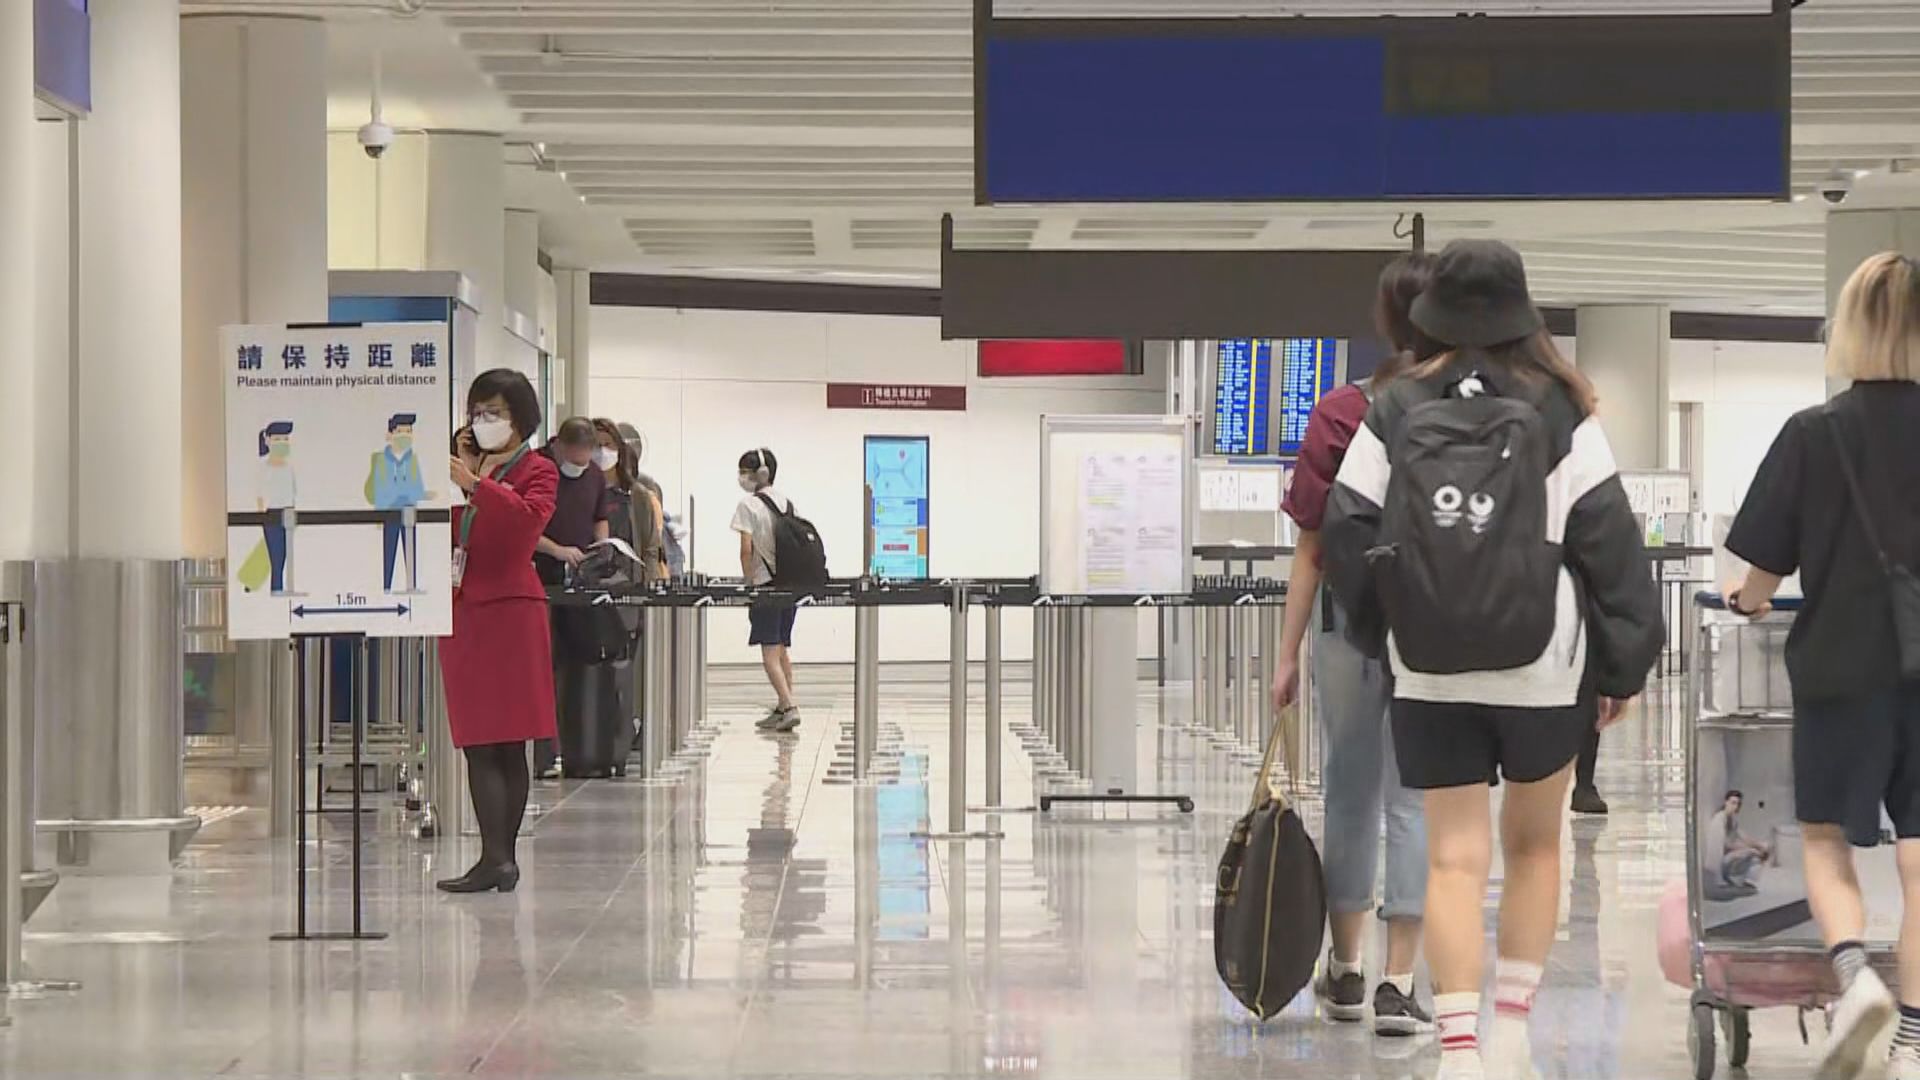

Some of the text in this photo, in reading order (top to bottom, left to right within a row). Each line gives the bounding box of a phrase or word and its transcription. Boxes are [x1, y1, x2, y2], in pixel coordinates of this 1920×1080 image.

[237, 342, 436, 370] 請保持距離
[237, 374, 436, 388] Please maintain physical distance
[336, 592, 367, 606] 1.5m
